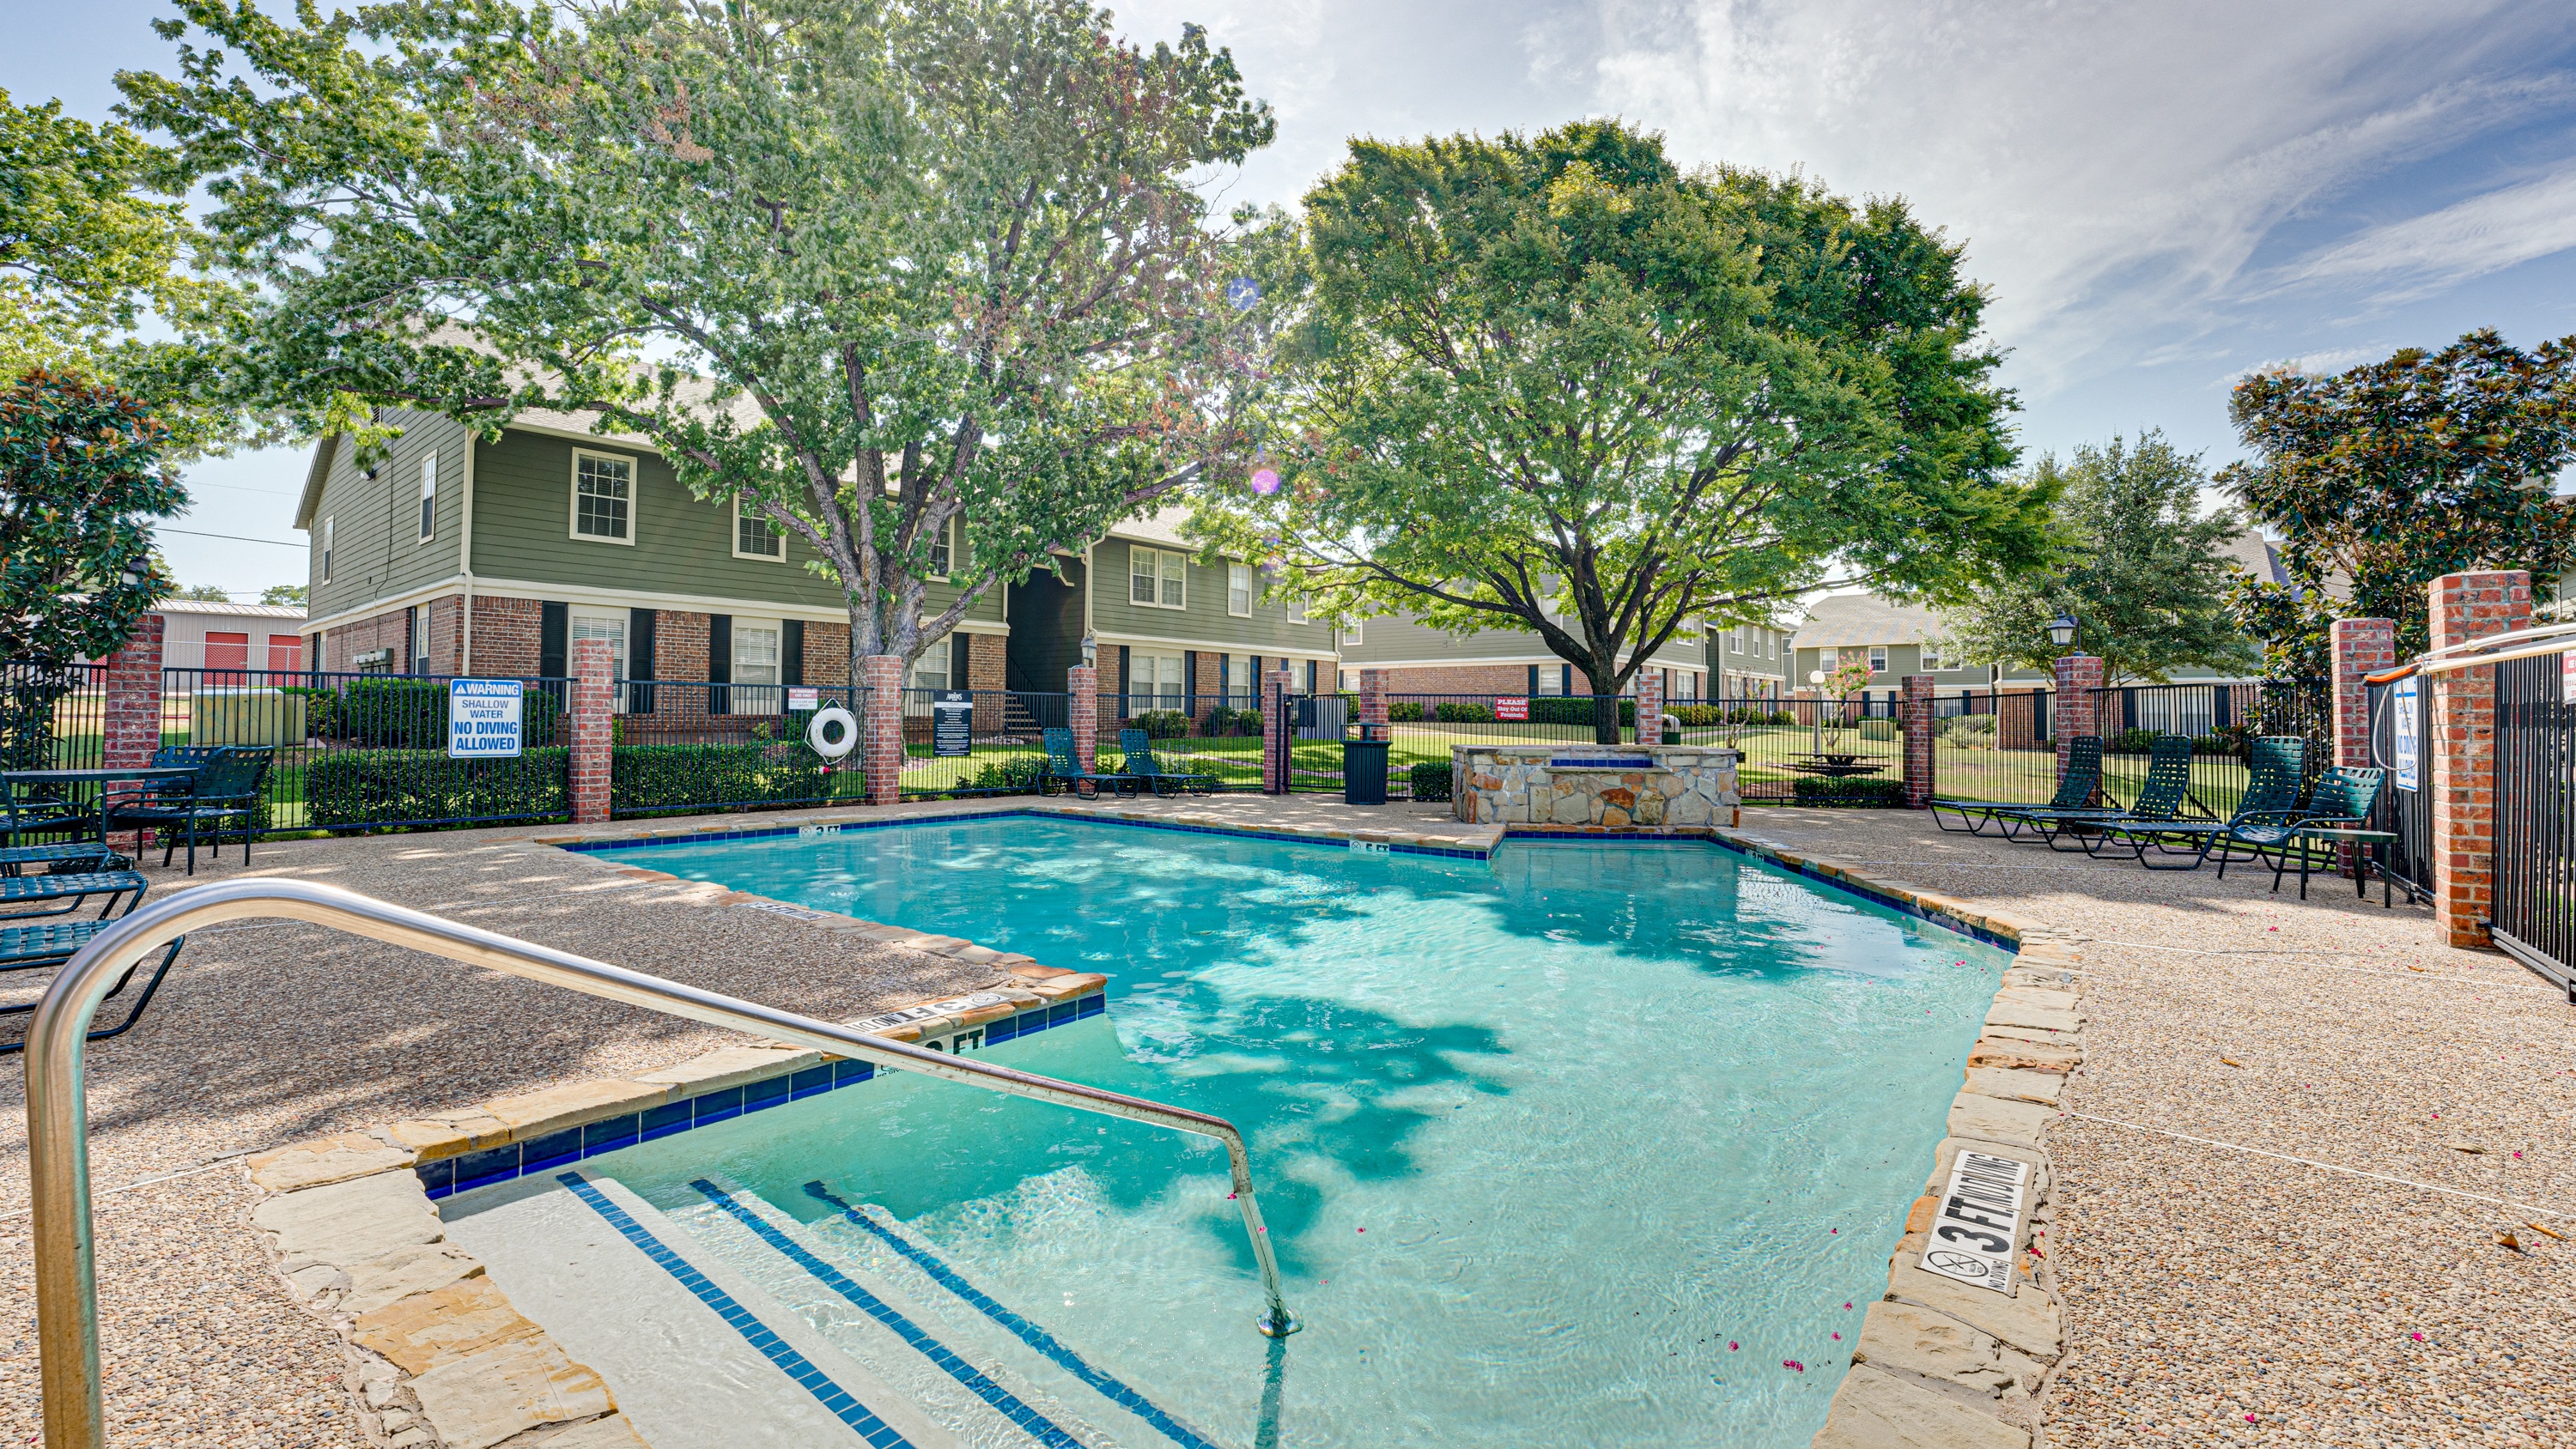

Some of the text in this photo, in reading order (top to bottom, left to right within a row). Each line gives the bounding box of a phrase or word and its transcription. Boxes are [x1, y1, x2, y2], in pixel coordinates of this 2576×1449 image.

[466, 683, 519, 695] WARNING
[462, 699, 509, 709] SHALLOW
[470, 710, 503, 718] WATER
[454, 721, 518, 735] NO DIVING
[455, 737, 515, 751] ALLOWED
[933, 1001, 967, 1012] 3
[872, 1015, 902, 1027] NO
[1959, 1154, 2020, 1193] DIVING
[1956, 1185, 2014, 1207] NO
[1937, 1225, 2010, 1253] 3
[1987, 1260, 2009, 1291] NO DIVING
